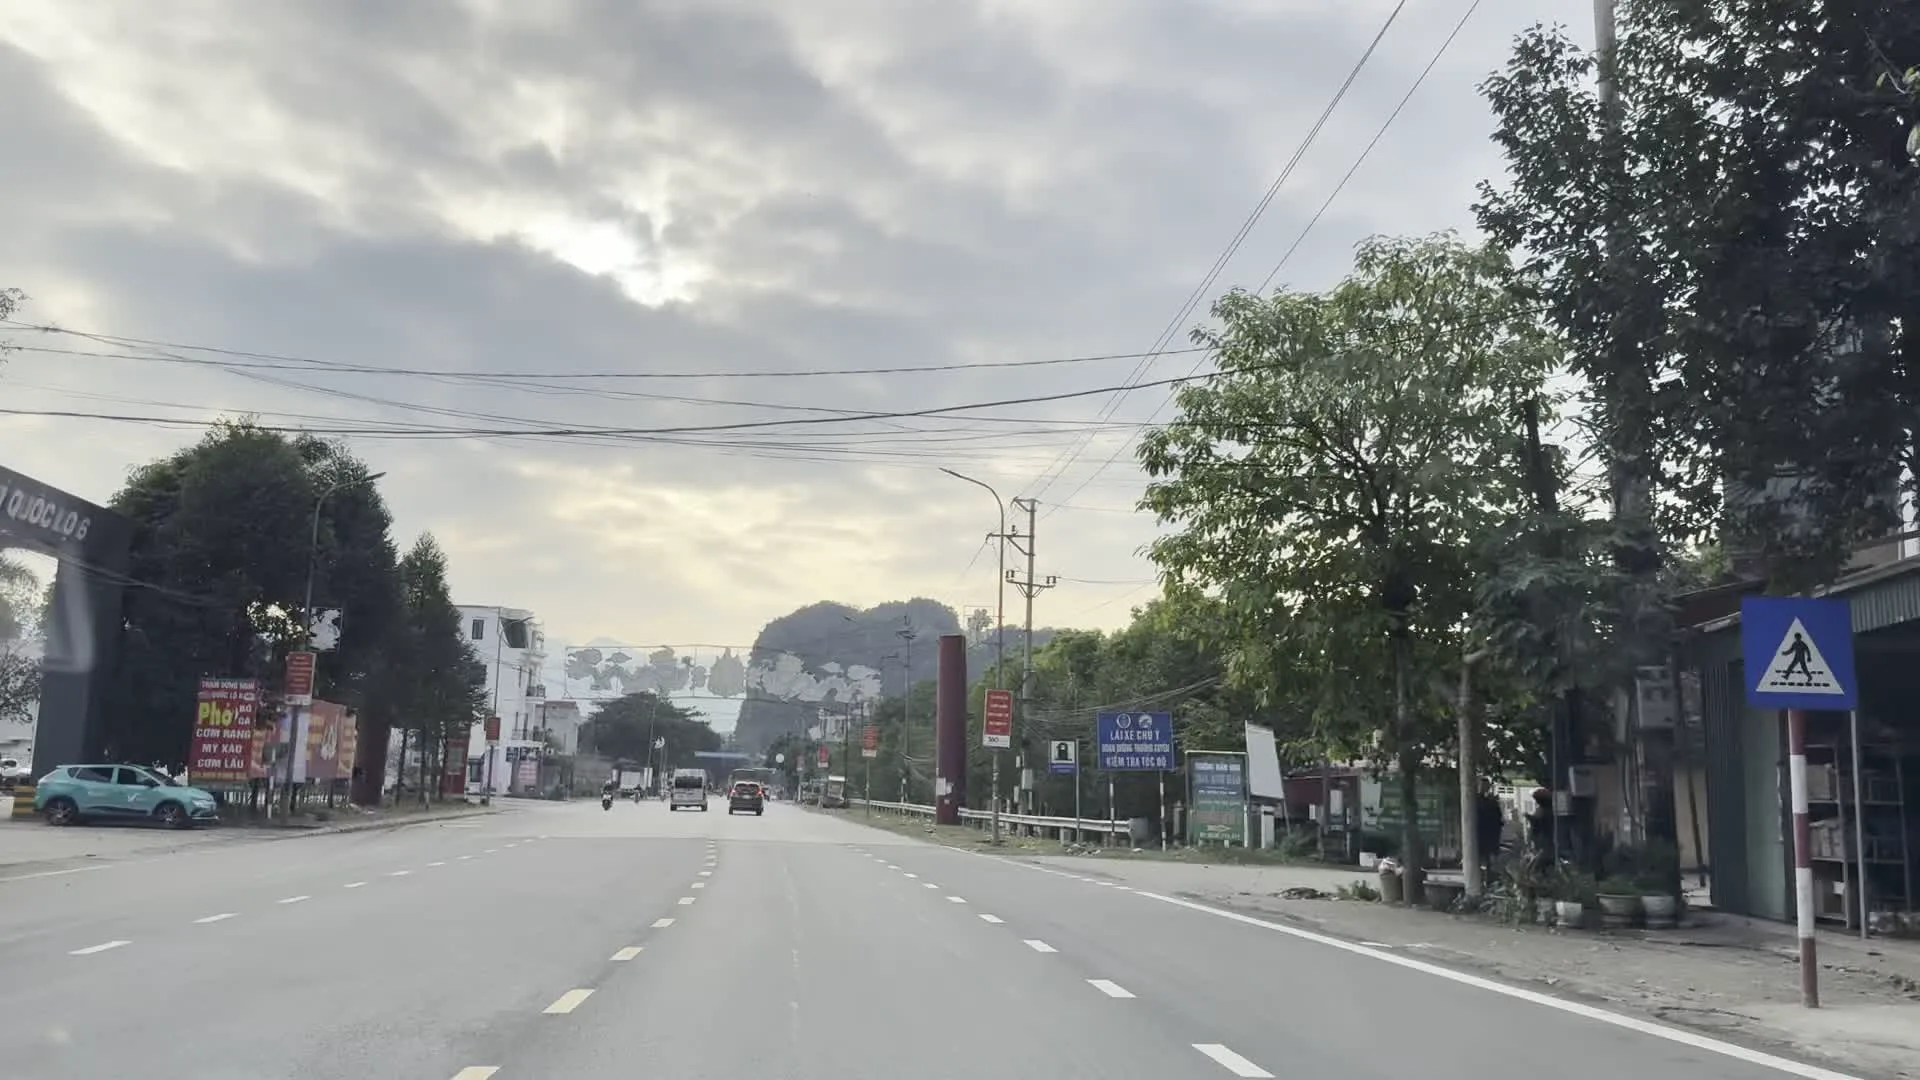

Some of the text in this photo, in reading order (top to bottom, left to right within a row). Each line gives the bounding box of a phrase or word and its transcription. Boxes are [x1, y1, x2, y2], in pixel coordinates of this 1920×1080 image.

[75, 517, 91, 540] 6
[197, 701, 234, 727] Phở
[1124, 730, 1134, 740] XE
